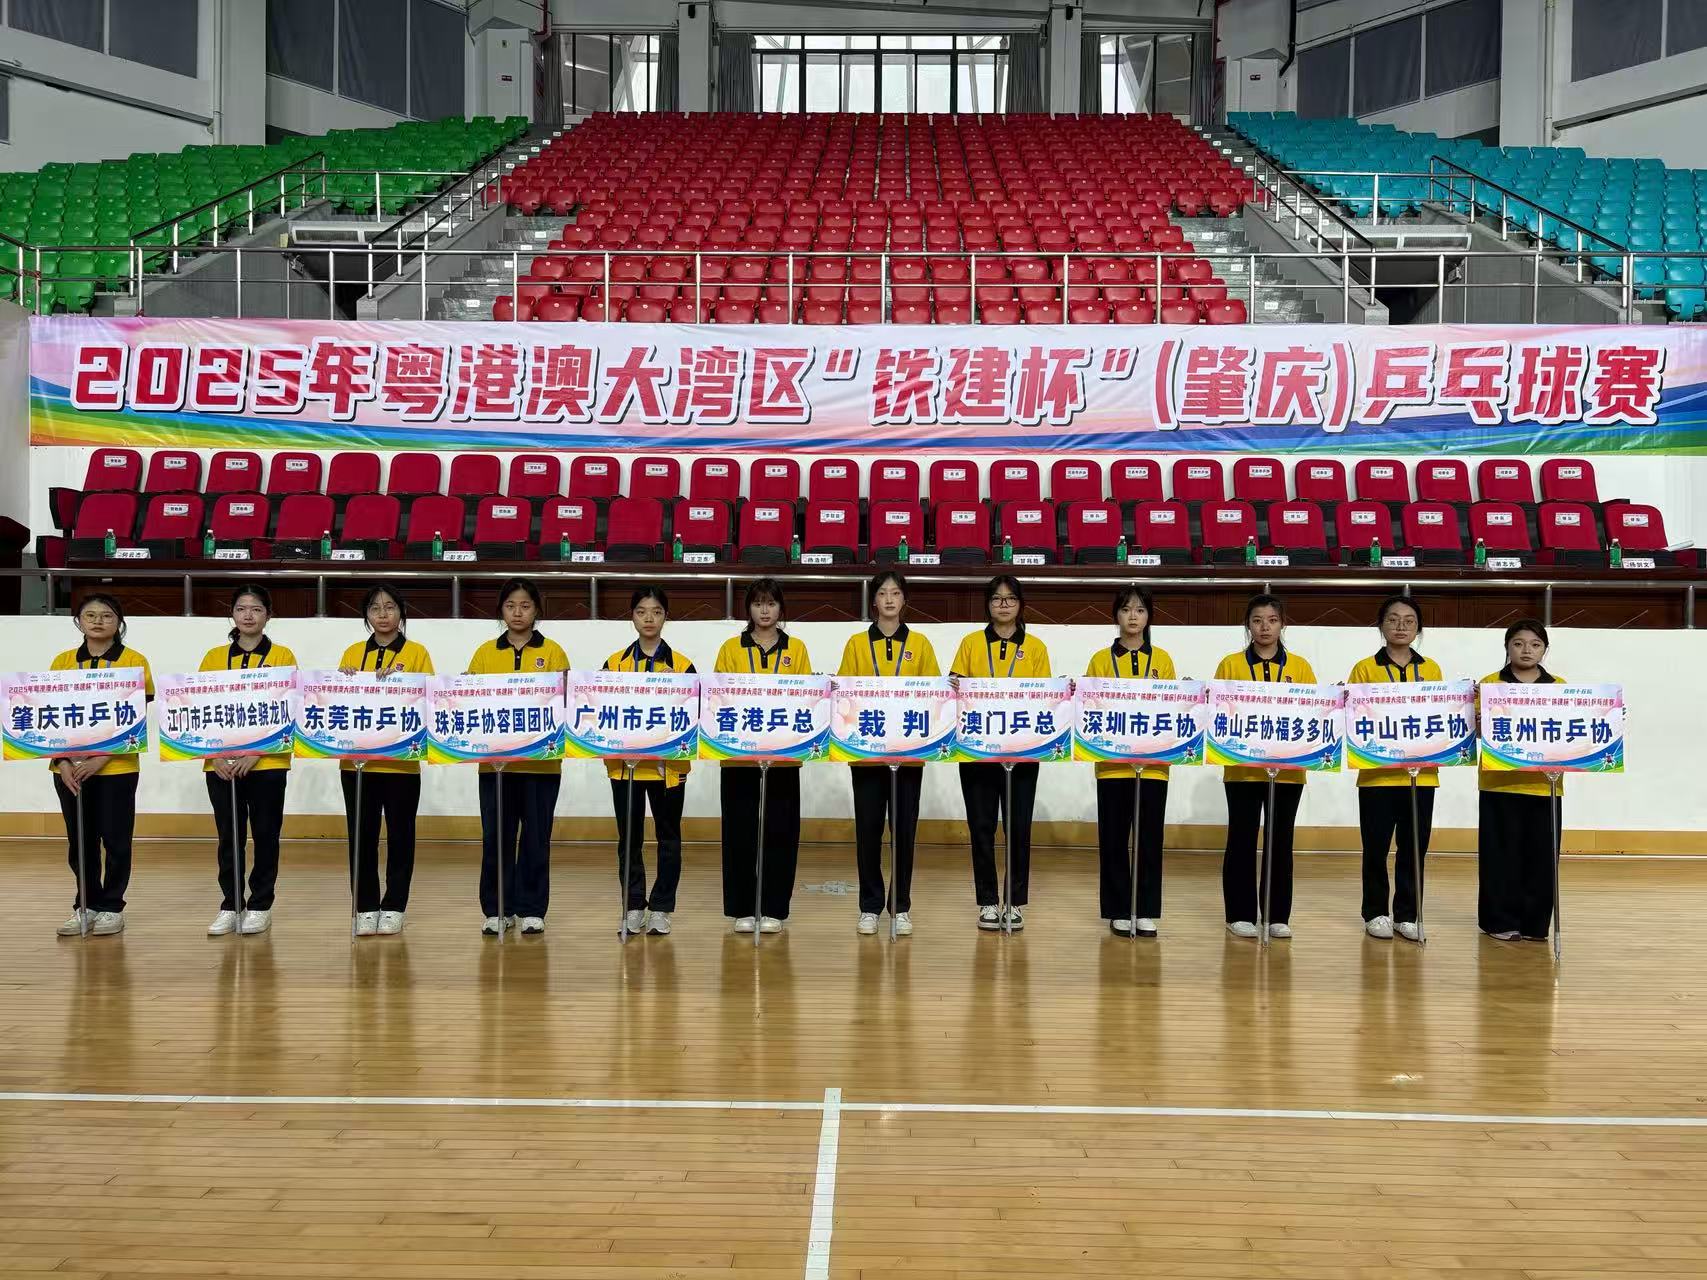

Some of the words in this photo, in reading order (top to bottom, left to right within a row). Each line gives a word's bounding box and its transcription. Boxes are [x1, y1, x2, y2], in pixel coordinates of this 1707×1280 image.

[71, 338, 1666, 430] 2025年粤港澳大湾区"铁建杯"(肇庆)乒乓球赛
[11, 700, 138, 732] 肇庆市乒协
[166, 701, 291, 732] 江门市乒乓球协会骁龙队
[304, 704, 422, 732] 东莞市乒协
[434, 706, 557, 736] 珠海乒协容国团队
[574, 704, 692, 732] 广州市乒协
[716, 706, 814, 734] 香港乒总
[858, 709, 929, 738] 裁判
[961, 710, 1053, 736] 澳门乒总
[1082, 711, 1197, 738] 深圳市乒协
[1214, 712, 1336, 744] 佛山乒协福多多队
[1355, 713, 1469, 742] 中山市乒协
[1492, 716, 1613, 744] 惠州市乒协
